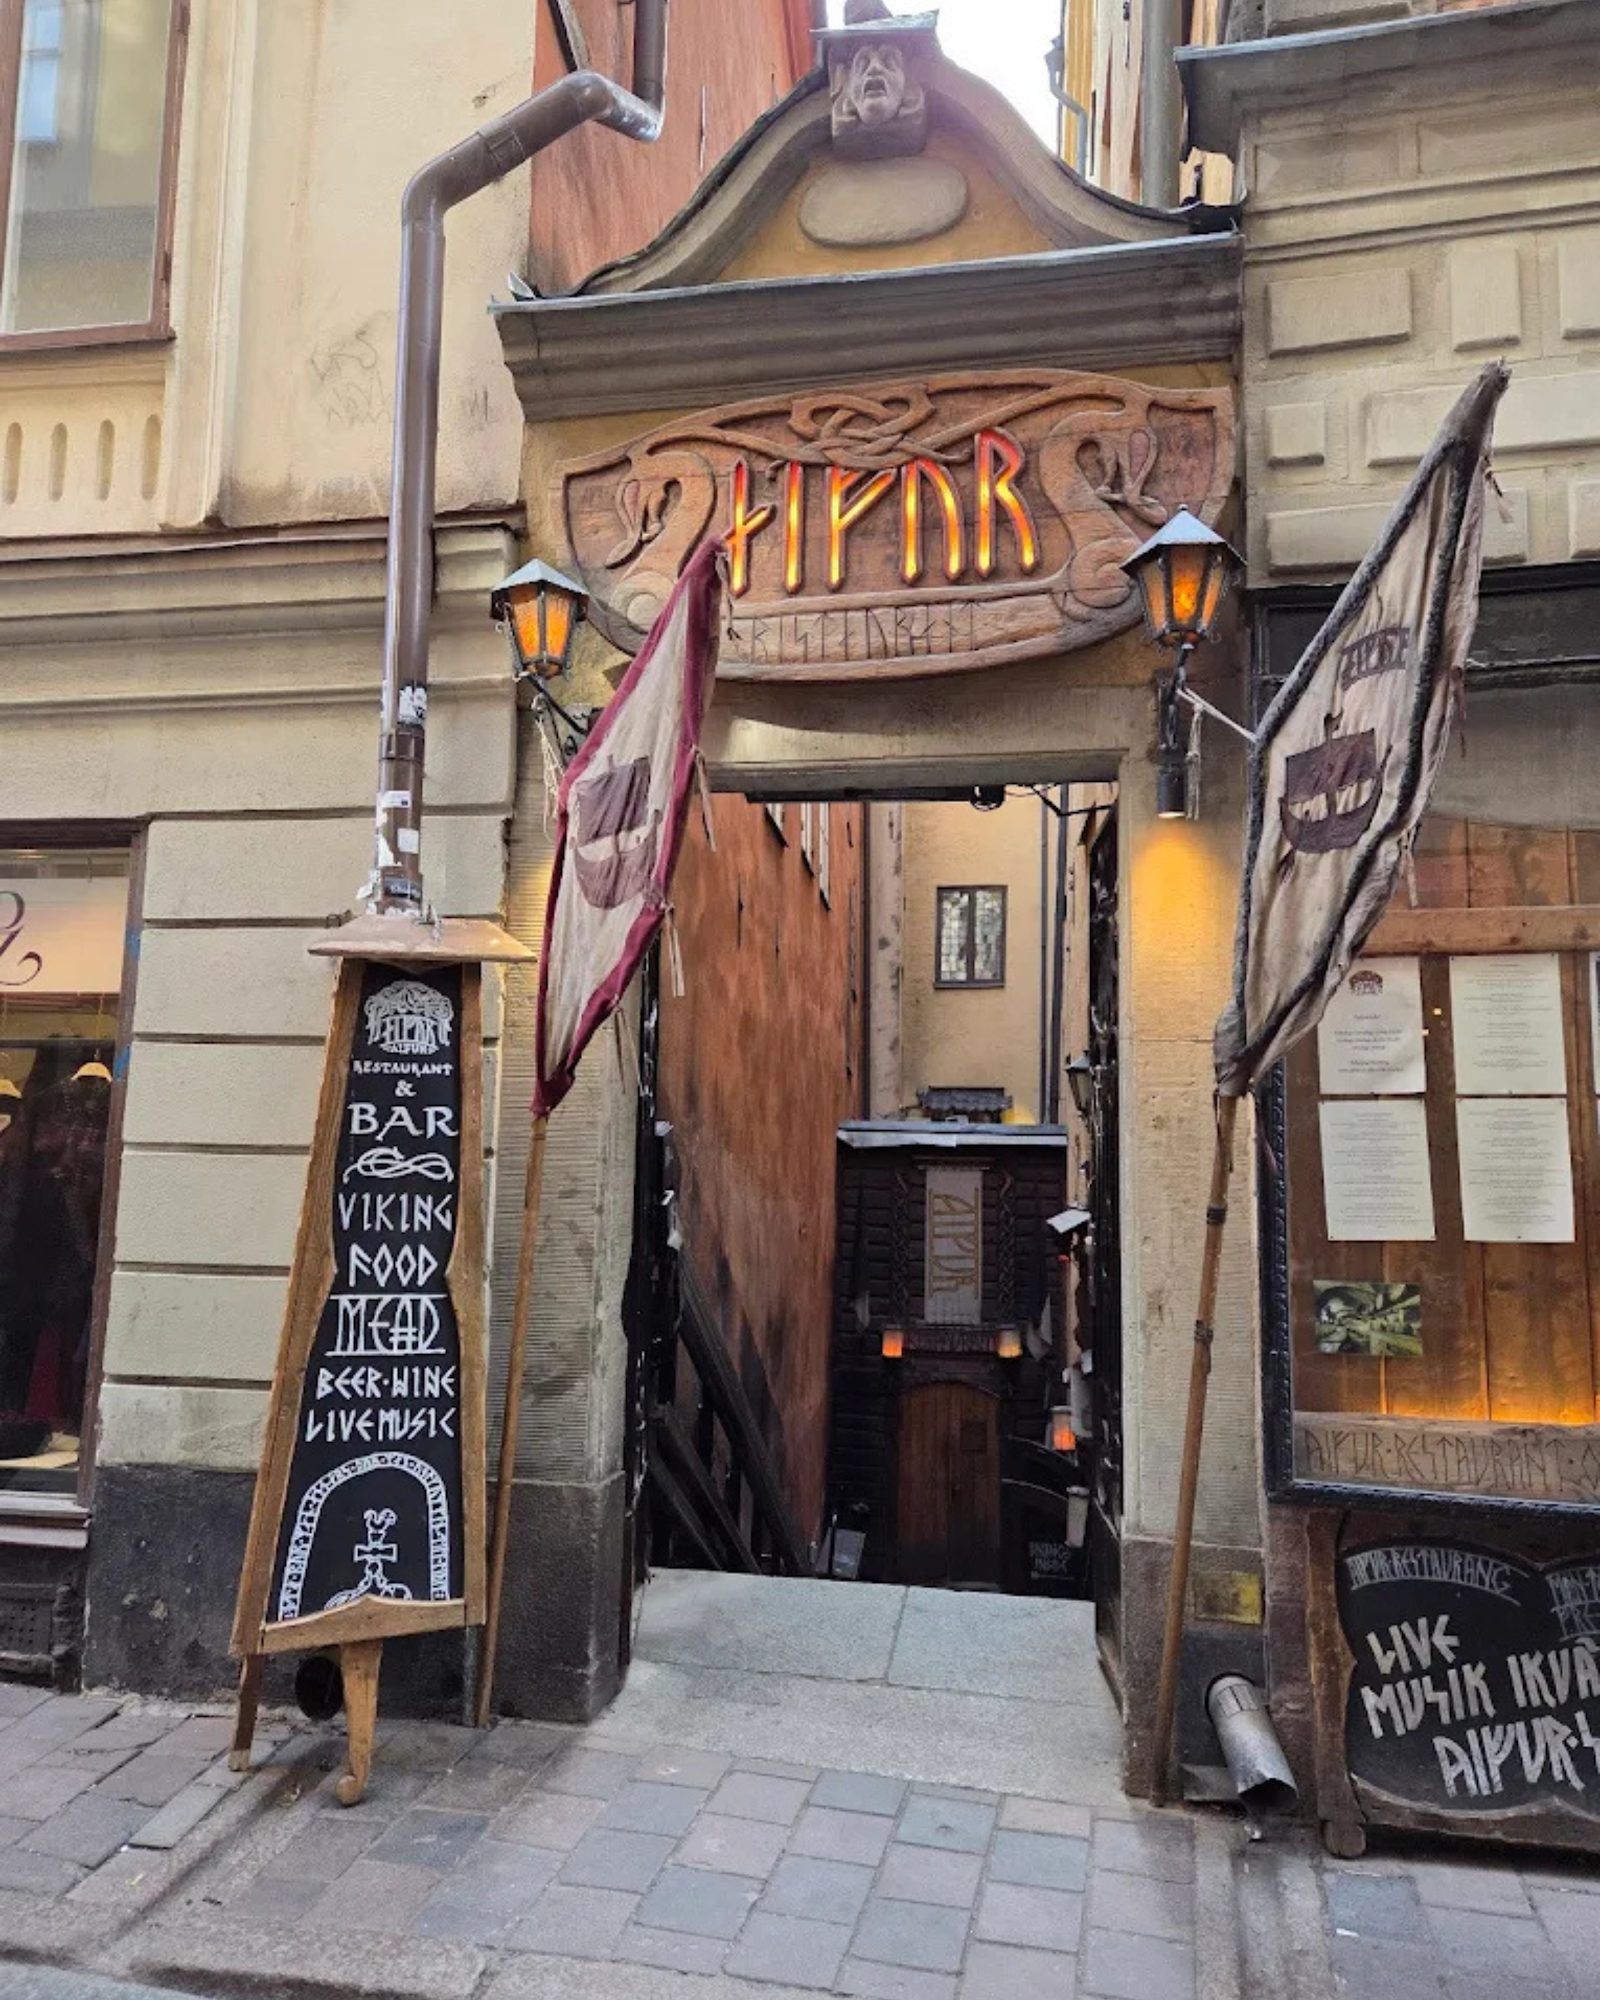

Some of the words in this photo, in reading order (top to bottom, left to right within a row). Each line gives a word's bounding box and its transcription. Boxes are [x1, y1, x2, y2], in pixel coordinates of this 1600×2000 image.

[352, 1060, 454, 1078] RESTAURANT
[394, 1079, 417, 1097] &
[347, 1102, 459, 1142] BAR
[338, 1192, 453, 1232] VIKING
[349, 1242, 439, 1288] FOOD
[333, 1295, 442, 1355] MEAD
[1366, 1614, 1460, 1674] LIVE
